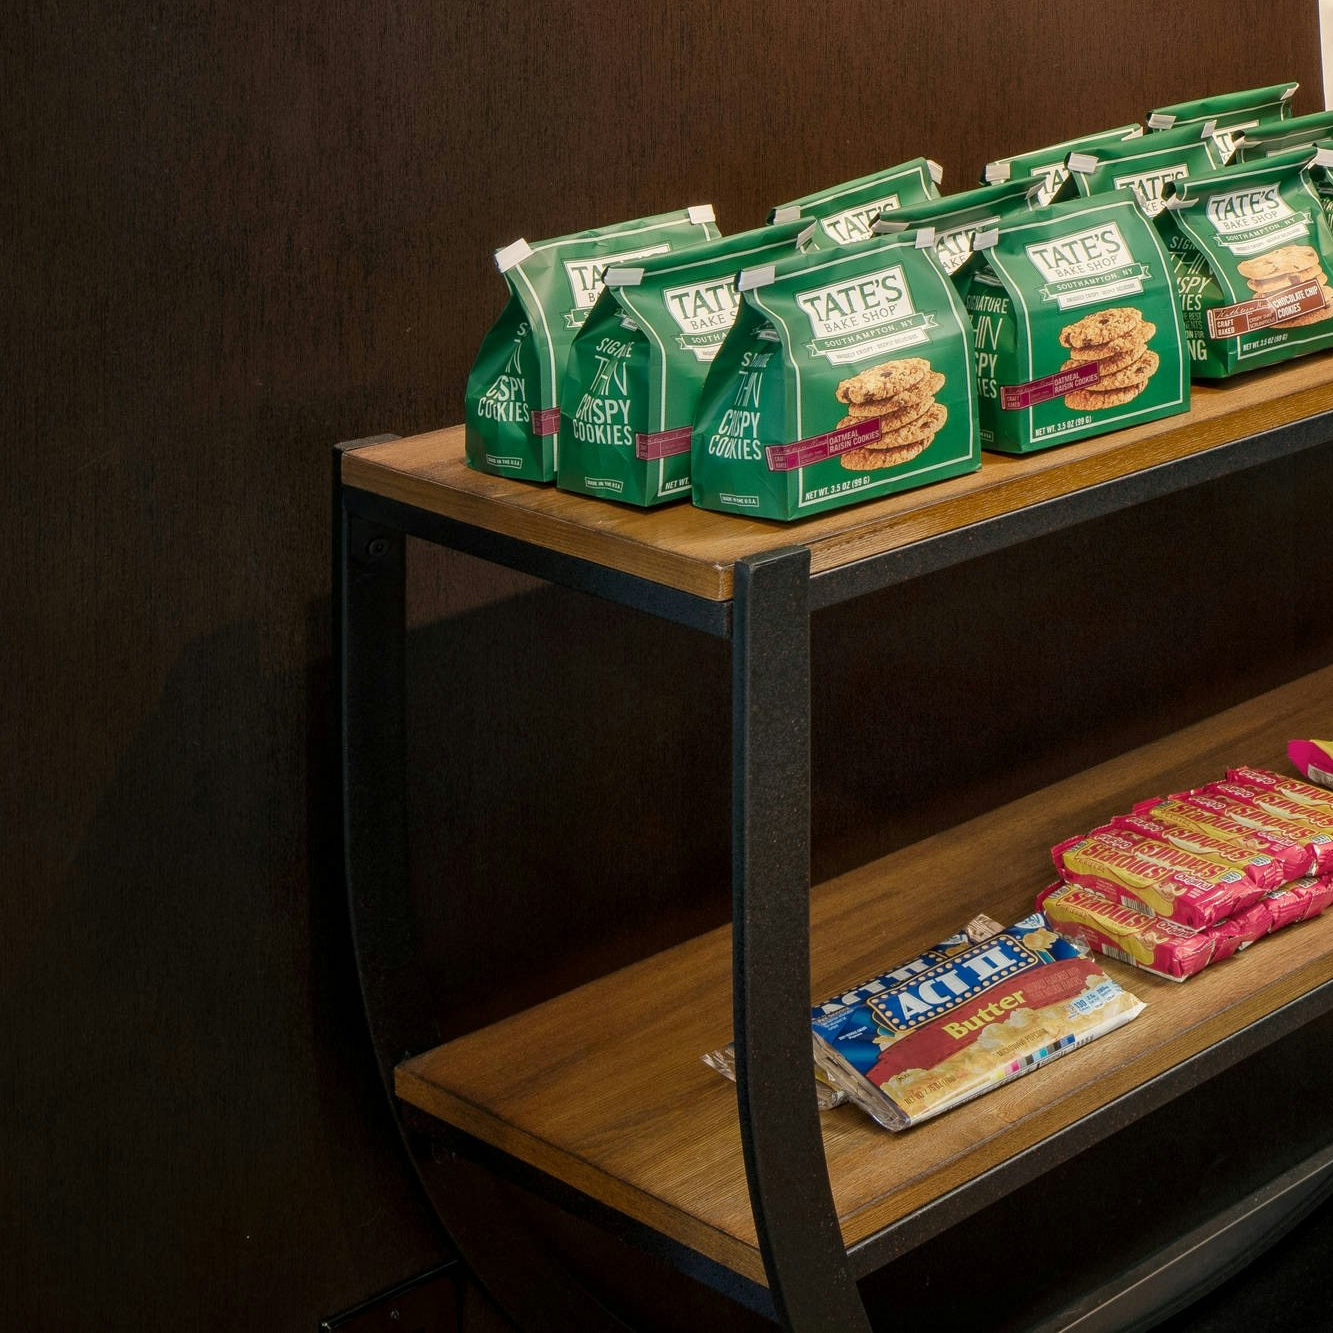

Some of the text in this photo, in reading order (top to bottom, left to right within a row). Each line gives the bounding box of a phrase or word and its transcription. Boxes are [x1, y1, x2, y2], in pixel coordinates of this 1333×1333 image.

[1212, 188, 1279, 220] TATE'S
[1224, 211, 1277, 230] BAKE SHOP
[1032, 230, 1121, 269] TATE'S
[1055, 256, 1117, 278] BAKE SHOP
[1121, 267, 1134, 276] NY
[802, 274, 904, 323] TATE'S
[1273, 285, 1318, 309] CHOCOLATE CHIP
[824, 305, 898, 333] BAKE SHOP
[1278, 303, 1301, 318] COOKIES
[690, 312, 727, 331] BAKE
[1216, 317, 1235, 328] CRAFT
[1216, 325, 1235, 335] BAKED
[824, 324, 898, 348] SOUTHAMPTON,
[900, 318, 914, 329] NY
[1054, 372, 1079, 386] OATMEAL
[1054, 373, 1098, 394] RAISIN COOKIES
[572, 418, 632, 446] COOKIES
[829, 429, 859, 446] OATMEAL
[829, 430, 880, 453] RAISIN COOKIES
[665, 480, 678, 490] NET
[805, 481, 851, 500] NET WT. 3.5 OZ
[1081, 840, 1216, 891] Starburst Original
[1156, 921, 1198, 939] Original
[896, 945, 1018, 1020] ACT II
[942, 989, 1028, 1040] Butter
